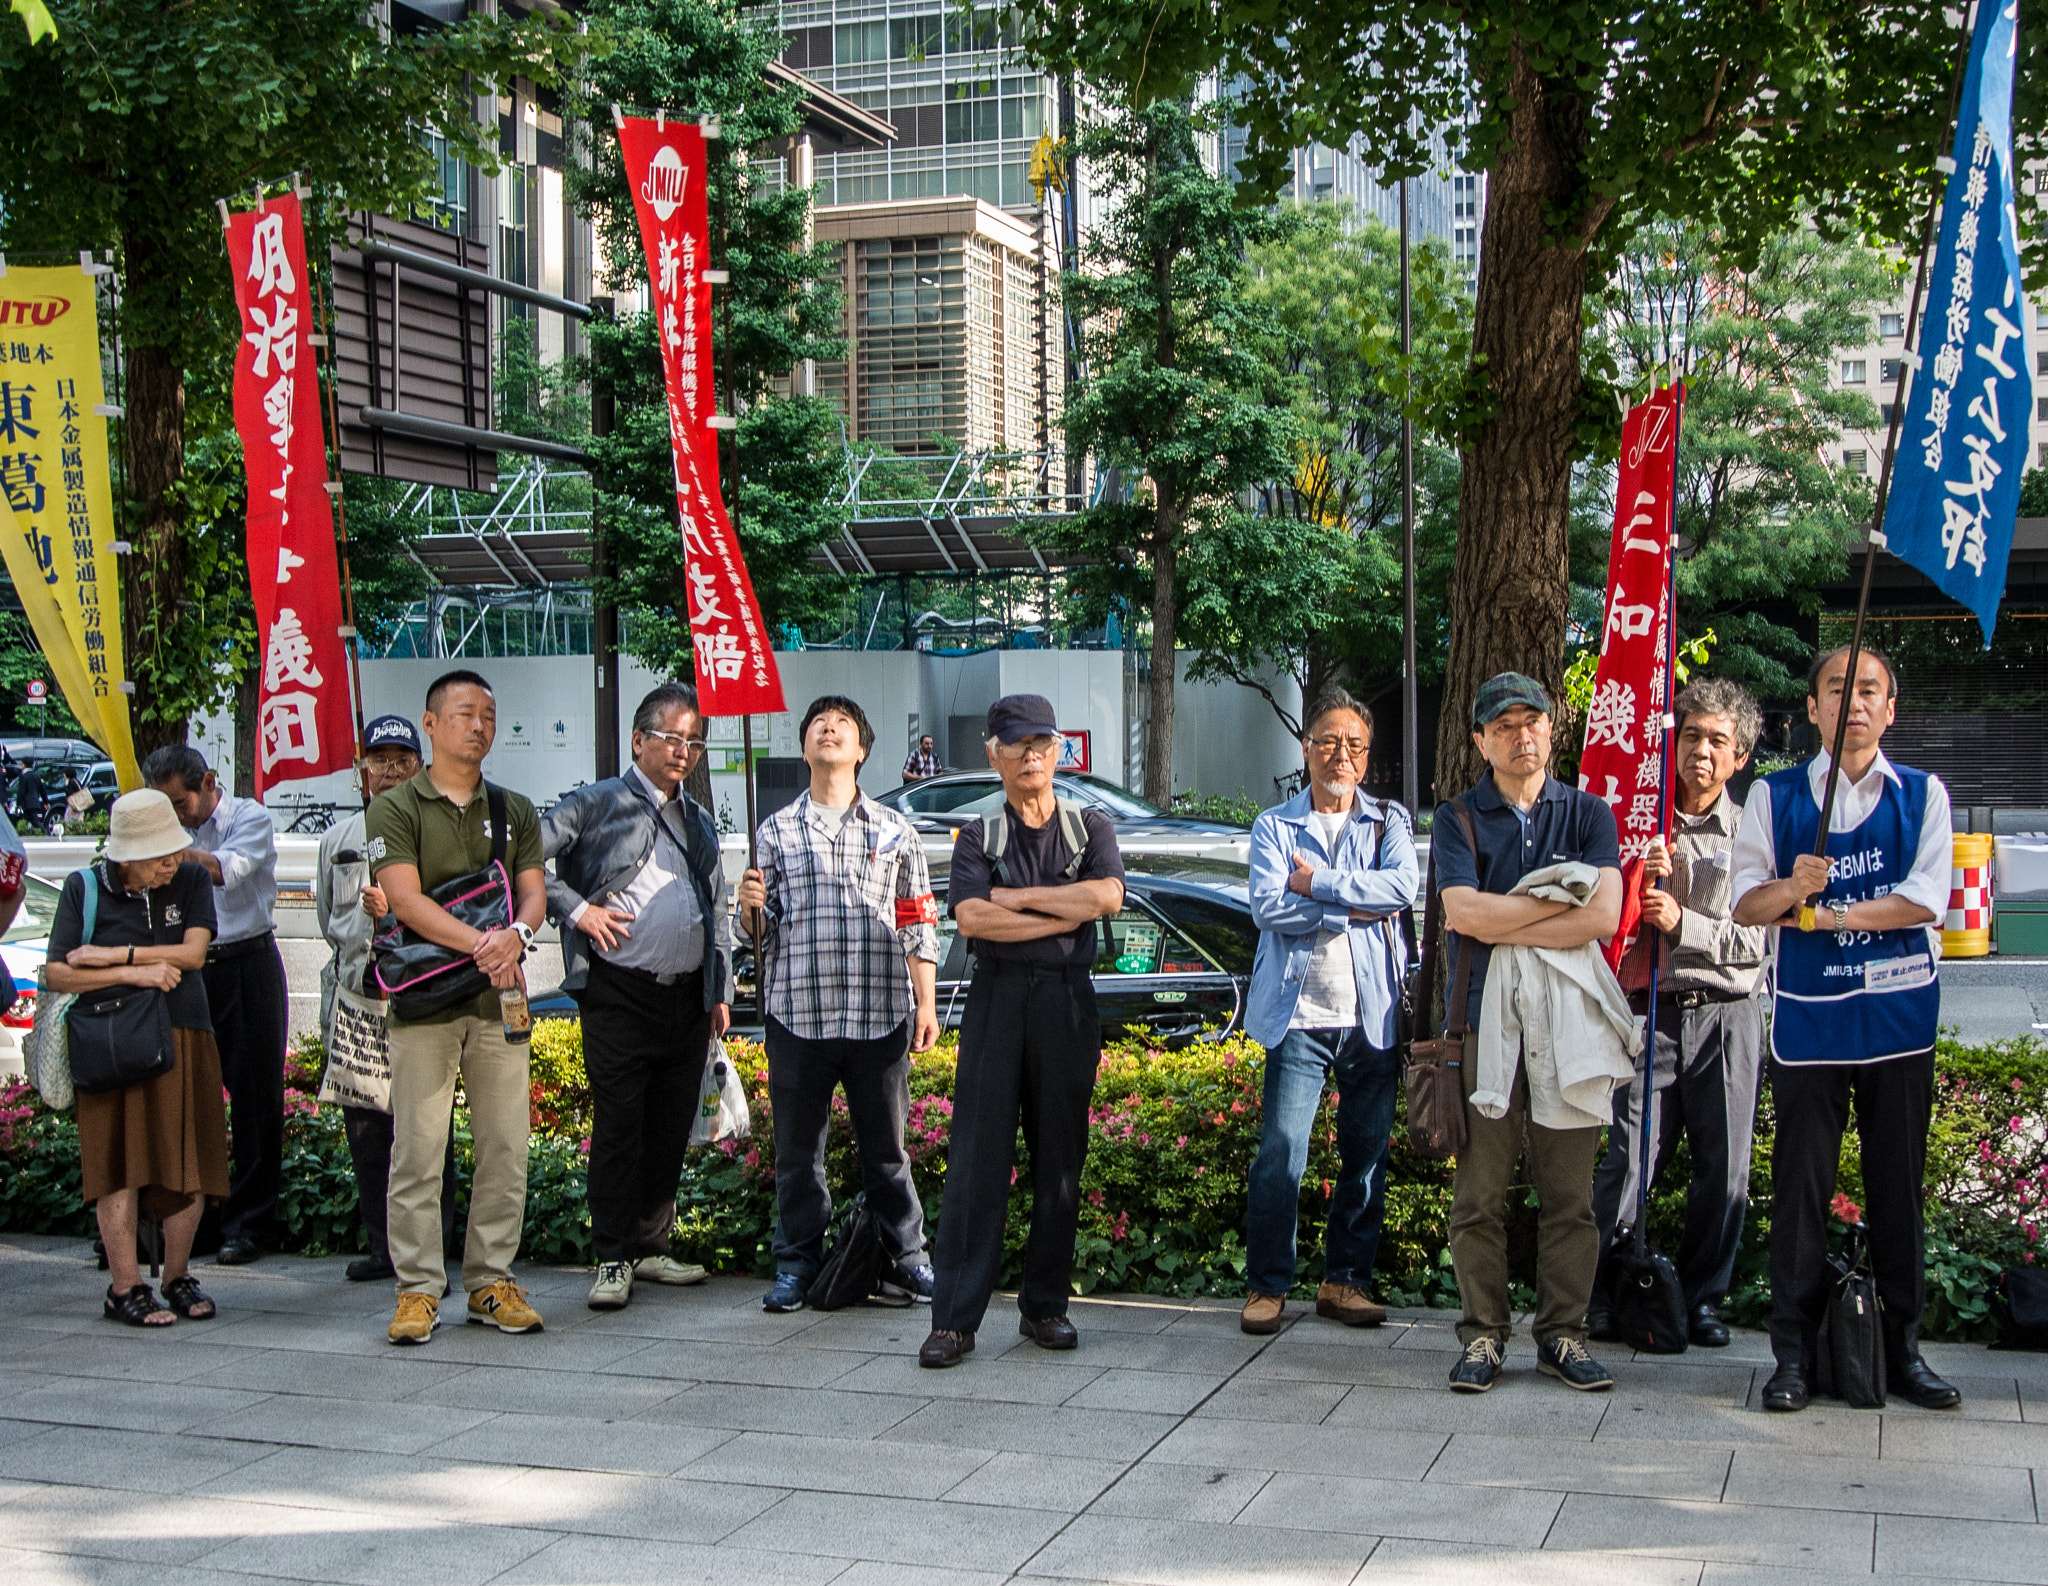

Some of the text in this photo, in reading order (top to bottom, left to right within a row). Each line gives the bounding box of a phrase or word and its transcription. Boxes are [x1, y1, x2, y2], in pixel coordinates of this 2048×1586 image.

[57, 378, 109, 698] 日本金属製造情報通信労働組合
